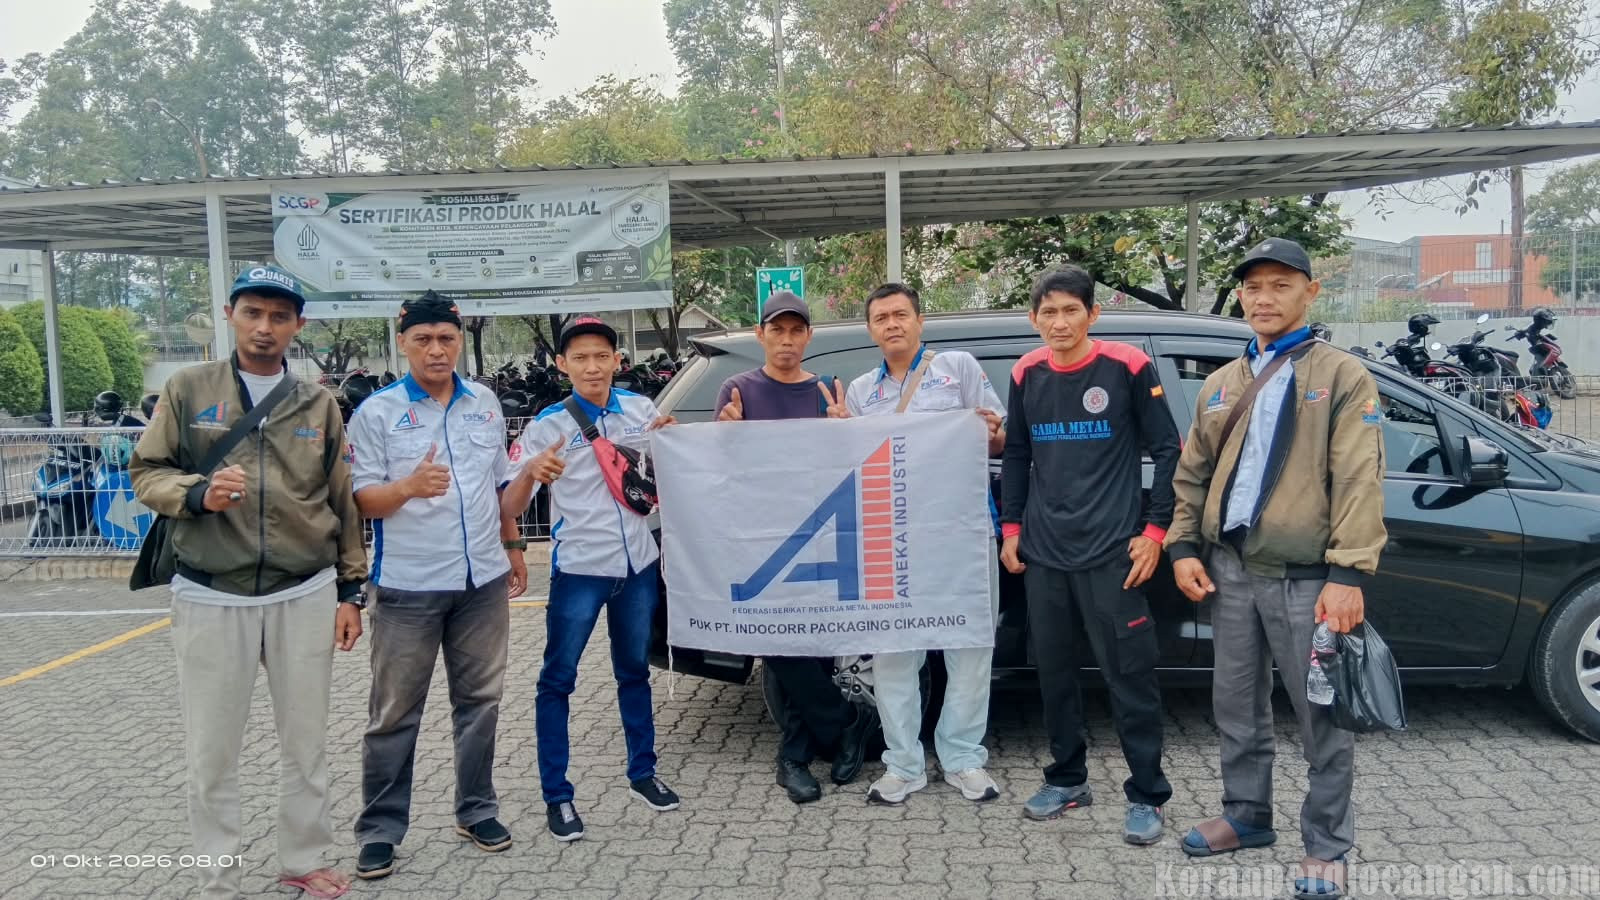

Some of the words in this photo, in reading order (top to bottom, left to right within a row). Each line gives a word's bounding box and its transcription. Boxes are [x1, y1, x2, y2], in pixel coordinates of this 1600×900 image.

[279, 196, 320, 209] SCGP
[441, 195, 500, 204] SOSIALISASI
[340, 207, 453, 224] SERTIFIKASI
[459, 203, 536, 222] PRODUK
[540, 200, 601, 218] HALAL
[501, 221, 539, 229] PELANGGAN
[1031, 422, 1065, 435] GARDA
[1069, 419, 1111, 433] METAL
[893, 436, 907, 525] INDUSTRI
[895, 531, 909, 598] ANEKA
[808, 605, 844, 613] PEKERJA
[871, 602, 912, 610] INDONESIA
[690, 618, 712, 632] PUK
[715, 623, 732, 632] PT.
[736, 624, 806, 635] INDOCORR
[810, 619, 890, 634] PACKAGING
[894, 614, 966, 630] CIKARANG
